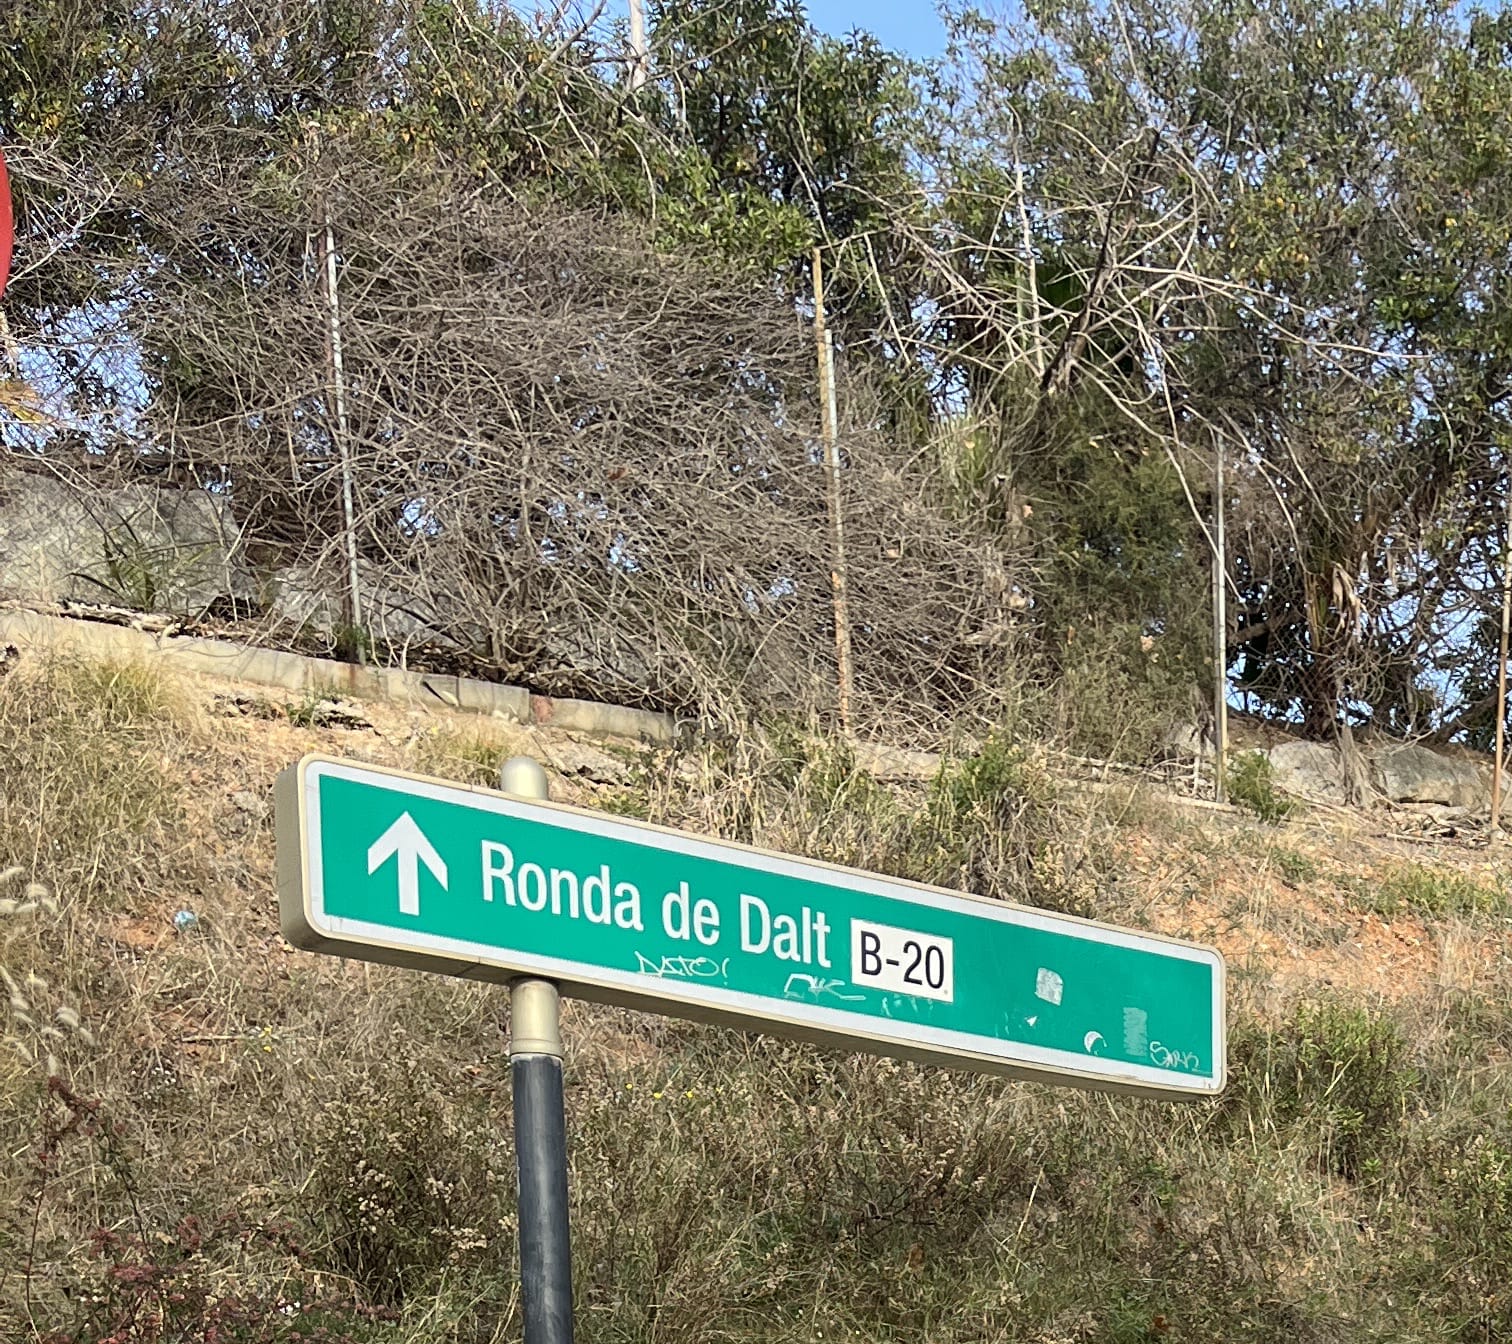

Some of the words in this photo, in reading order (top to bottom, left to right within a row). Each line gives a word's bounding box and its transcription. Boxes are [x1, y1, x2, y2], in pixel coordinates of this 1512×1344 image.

[481, 839, 644, 932] Ronda
[662, 881, 720, 946] de
[739, 893, 832, 969] Dalt
[860, 930, 946, 990] B-20
